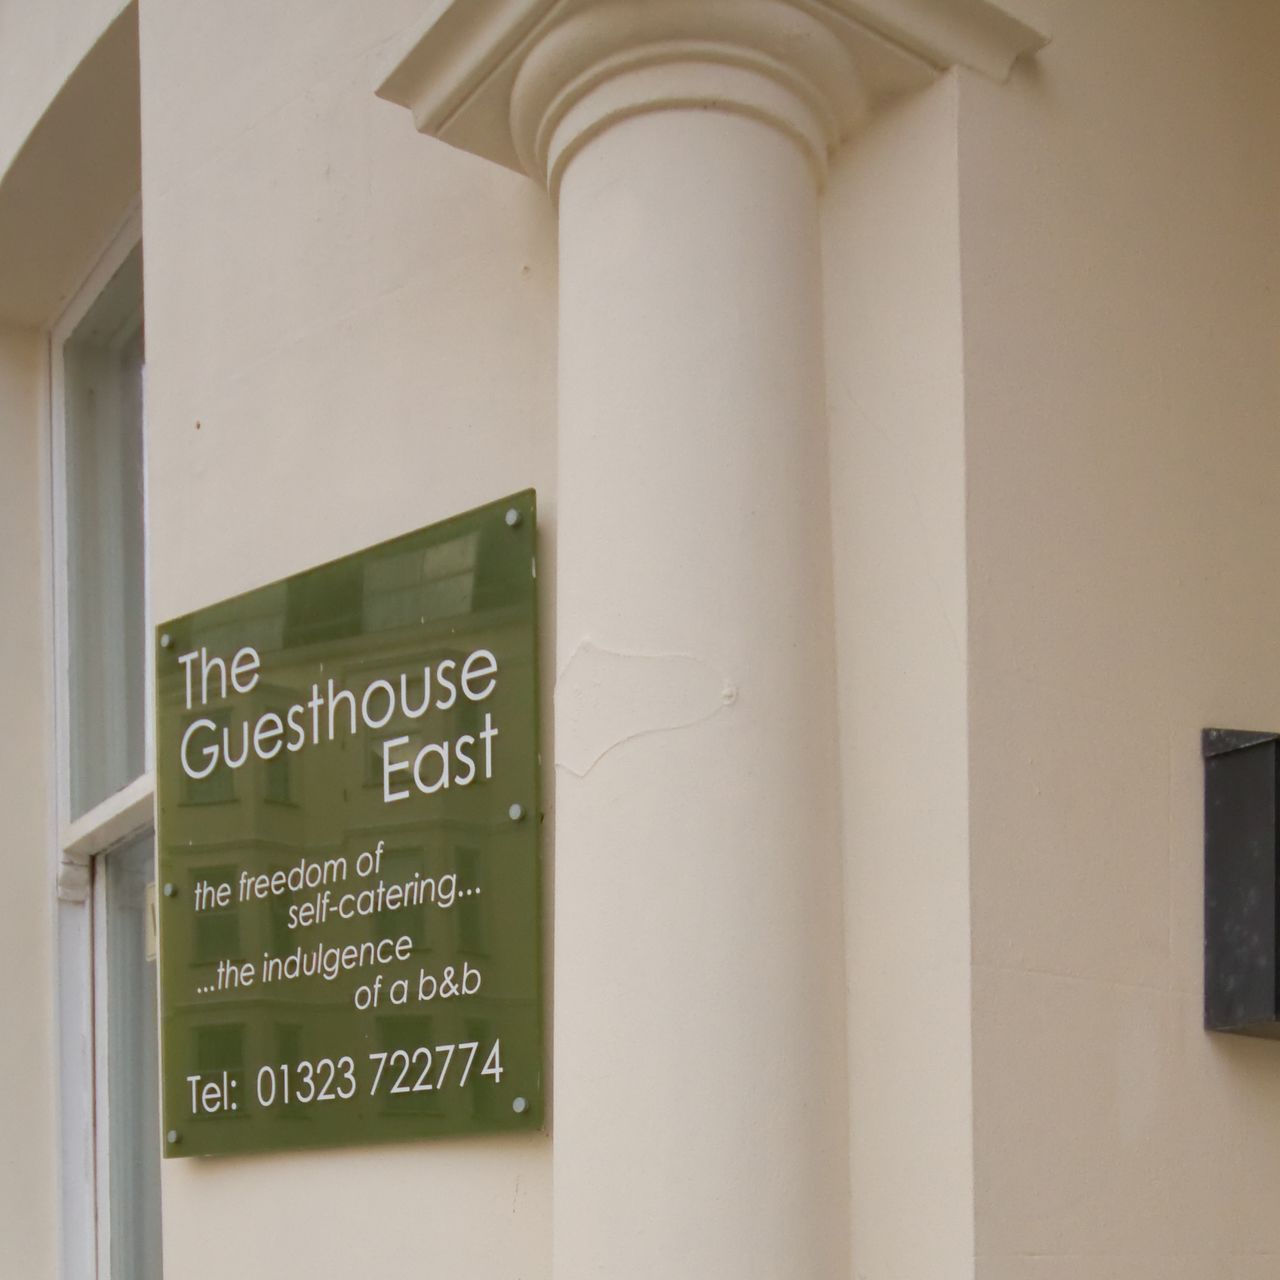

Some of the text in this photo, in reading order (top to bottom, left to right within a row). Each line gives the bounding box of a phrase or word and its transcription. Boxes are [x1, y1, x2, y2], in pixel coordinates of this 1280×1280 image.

[178, 646, 261, 710] The
[180, 649, 498, 780] Guesthouse
[382, 712, 499, 803] East
[194, 840, 385, 911] the freedom of
[287, 872, 481, 929] self-catering...
[197, 935, 413, 994] ...the indulgence
[354, 961, 482, 1010] of a b&b
[186, 1038, 504, 1114] Tel: 01323 722774
